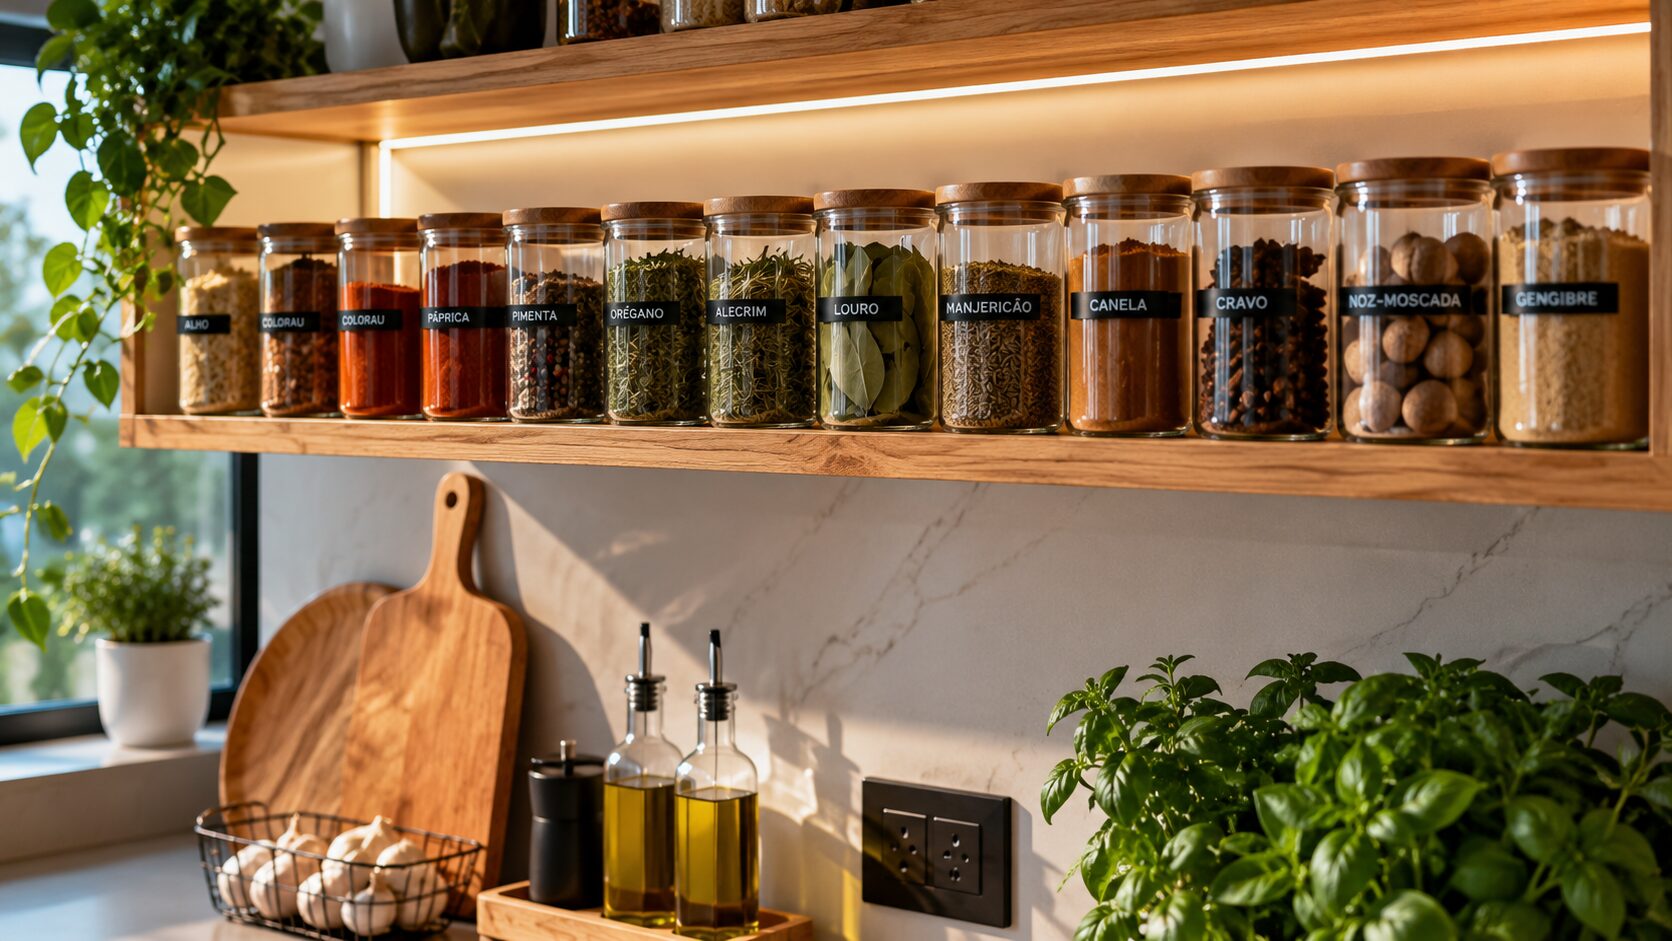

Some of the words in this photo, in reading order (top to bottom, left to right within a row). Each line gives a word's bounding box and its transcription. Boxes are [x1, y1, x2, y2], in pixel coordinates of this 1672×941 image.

[1089, 298, 1147, 311] CANELA
[1216, 296, 1268, 310] CRAVO
[1349, 293, 1461, 308] NOZ-MOSCADA
[1515, 291, 1598, 307] GENGIBRE
[512, 310, 557, 321] PIMENTA
[610, 305, 664, 320] ORÉGANO
[715, 305, 767, 317] ALECRIM
[834, 302, 879, 316] LOURO
[262, 317, 305, 328] COLORAU
[342, 314, 385, 326] COLORAU
[428, 310, 470, 323] PÁPRICA
[184, 319, 209, 330] ALHO
